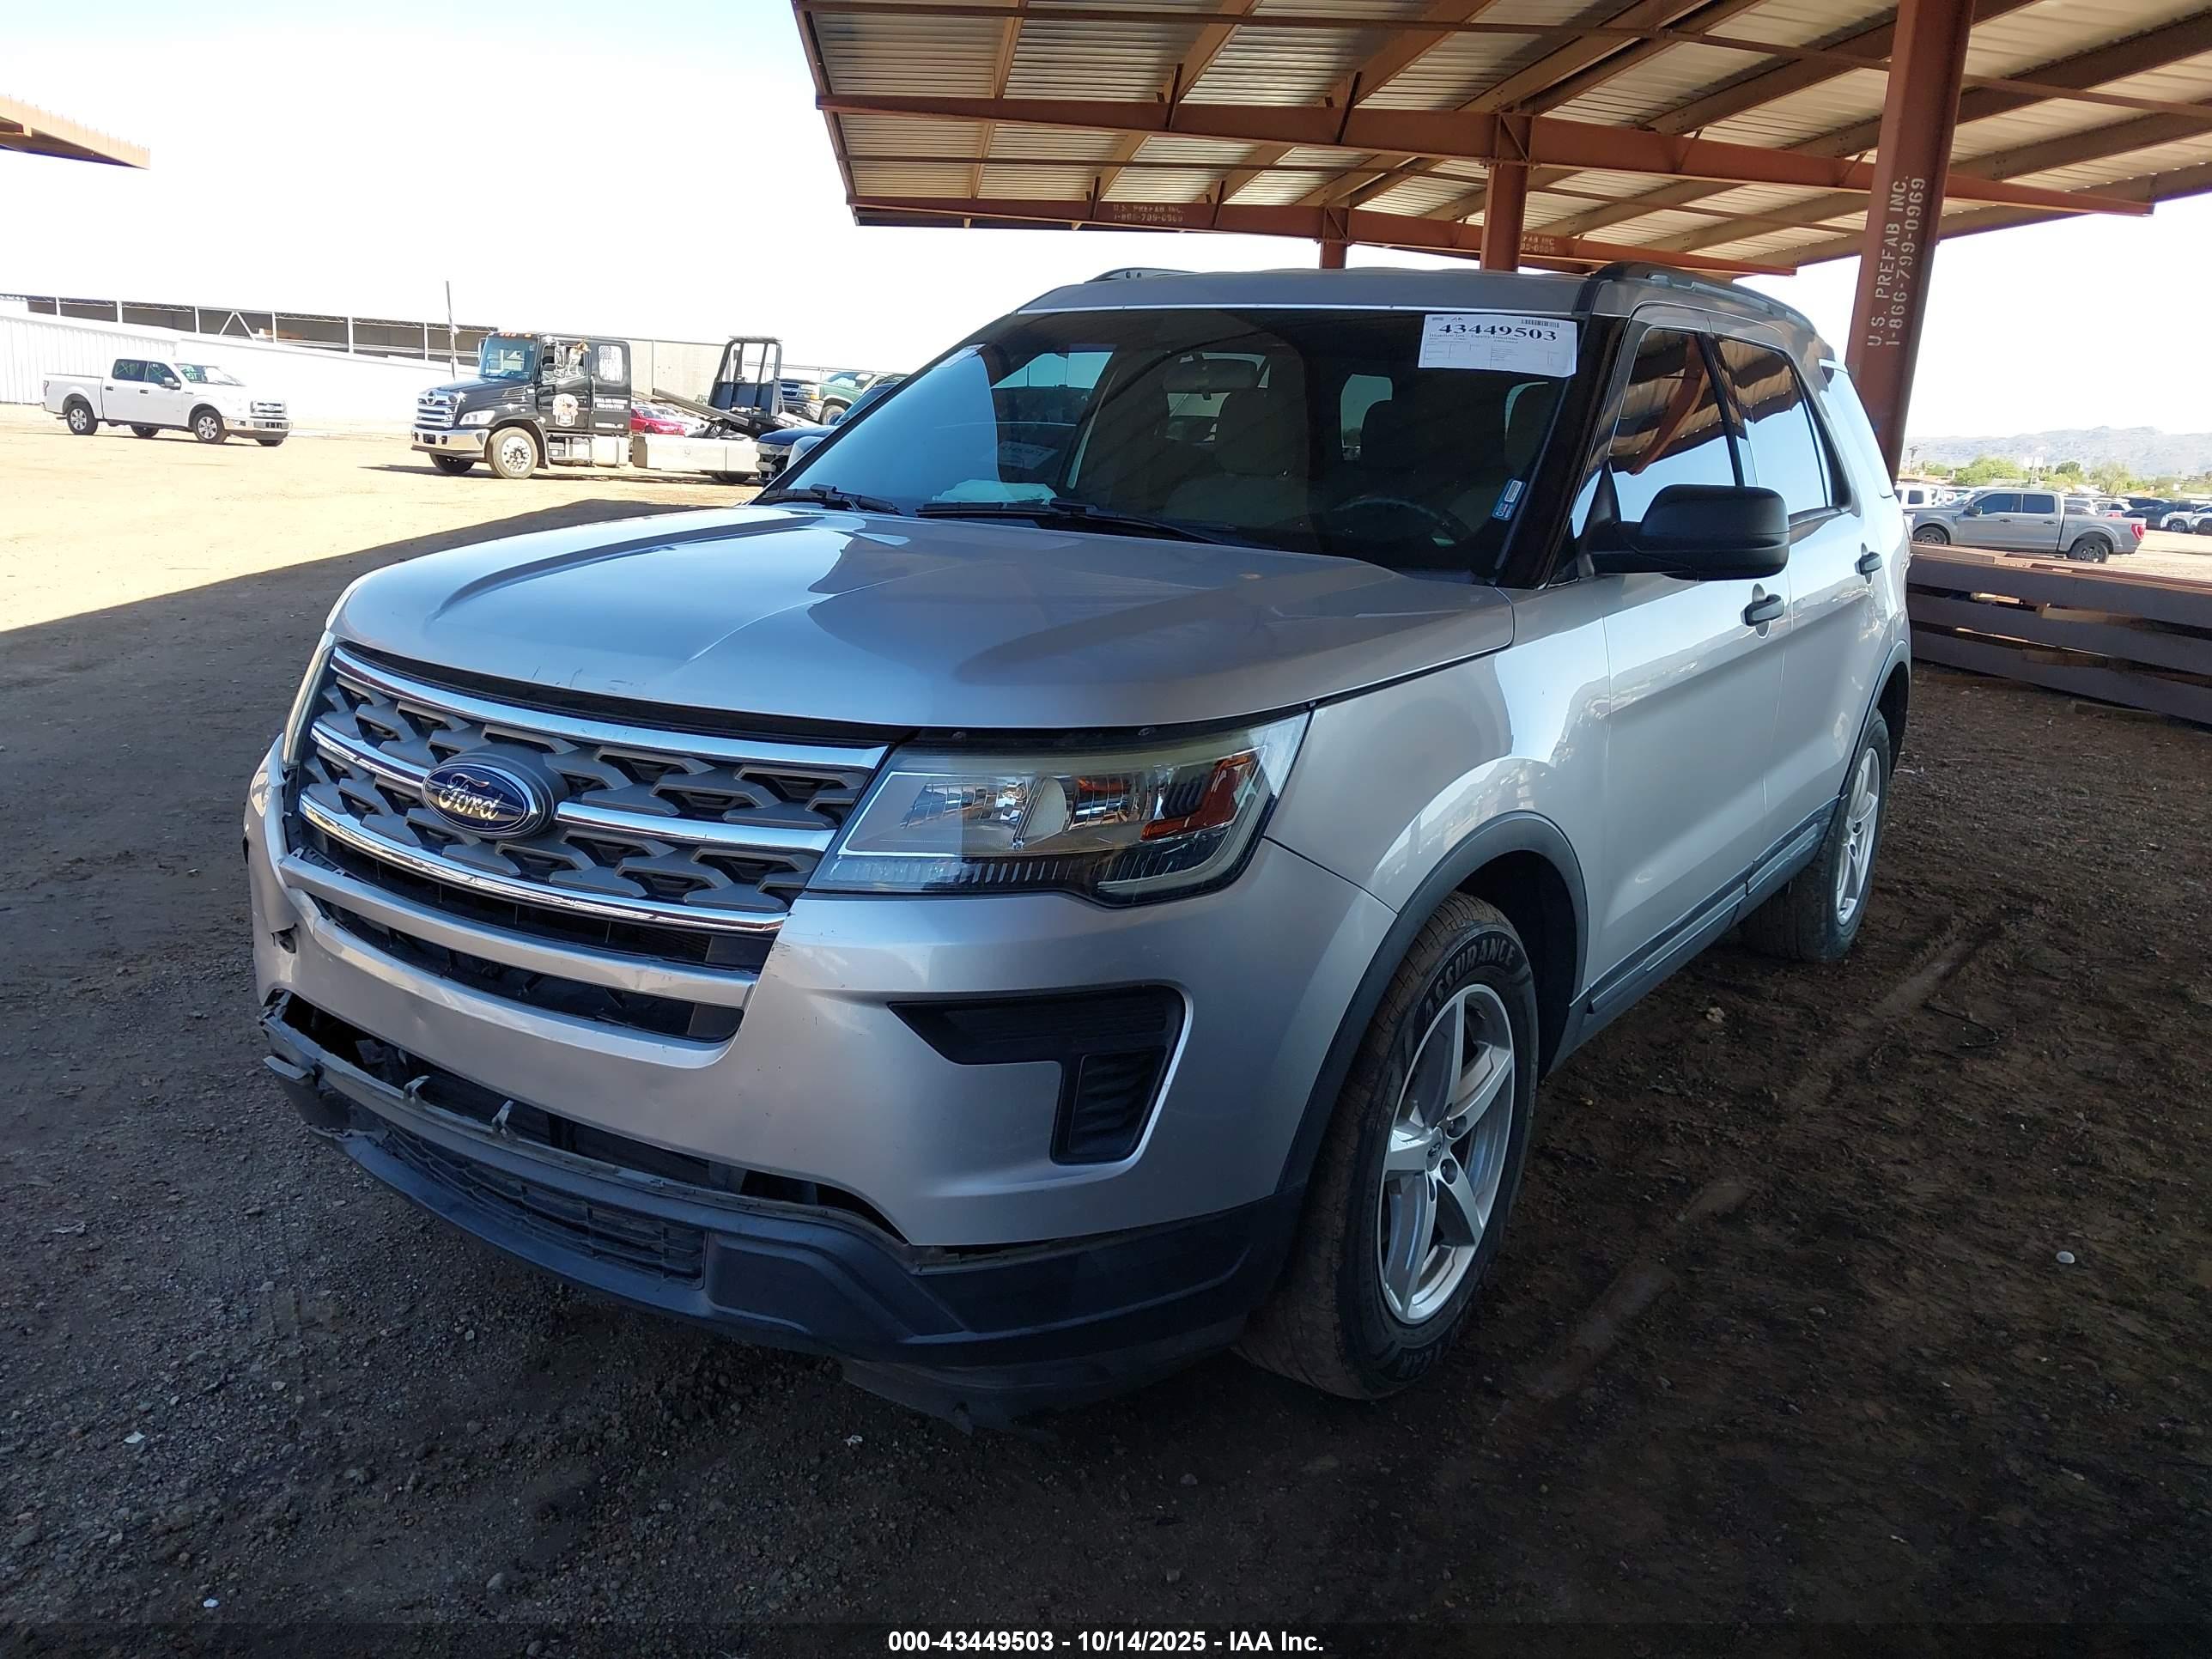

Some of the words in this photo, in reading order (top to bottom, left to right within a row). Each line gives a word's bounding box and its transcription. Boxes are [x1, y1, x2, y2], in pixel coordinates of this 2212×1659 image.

[1889, 175, 1909, 212] INC.
[1875, 222, 1900, 299] PREFAB
[1886, 178, 1925, 346] 1-866-799-0969
[1438, 324, 1557, 342] 43449503
[1867, 311, 1887, 347] U.S.
[438, 773, 503, 820] Ford
[1425, 938, 1515, 1024] ASSURANCE
